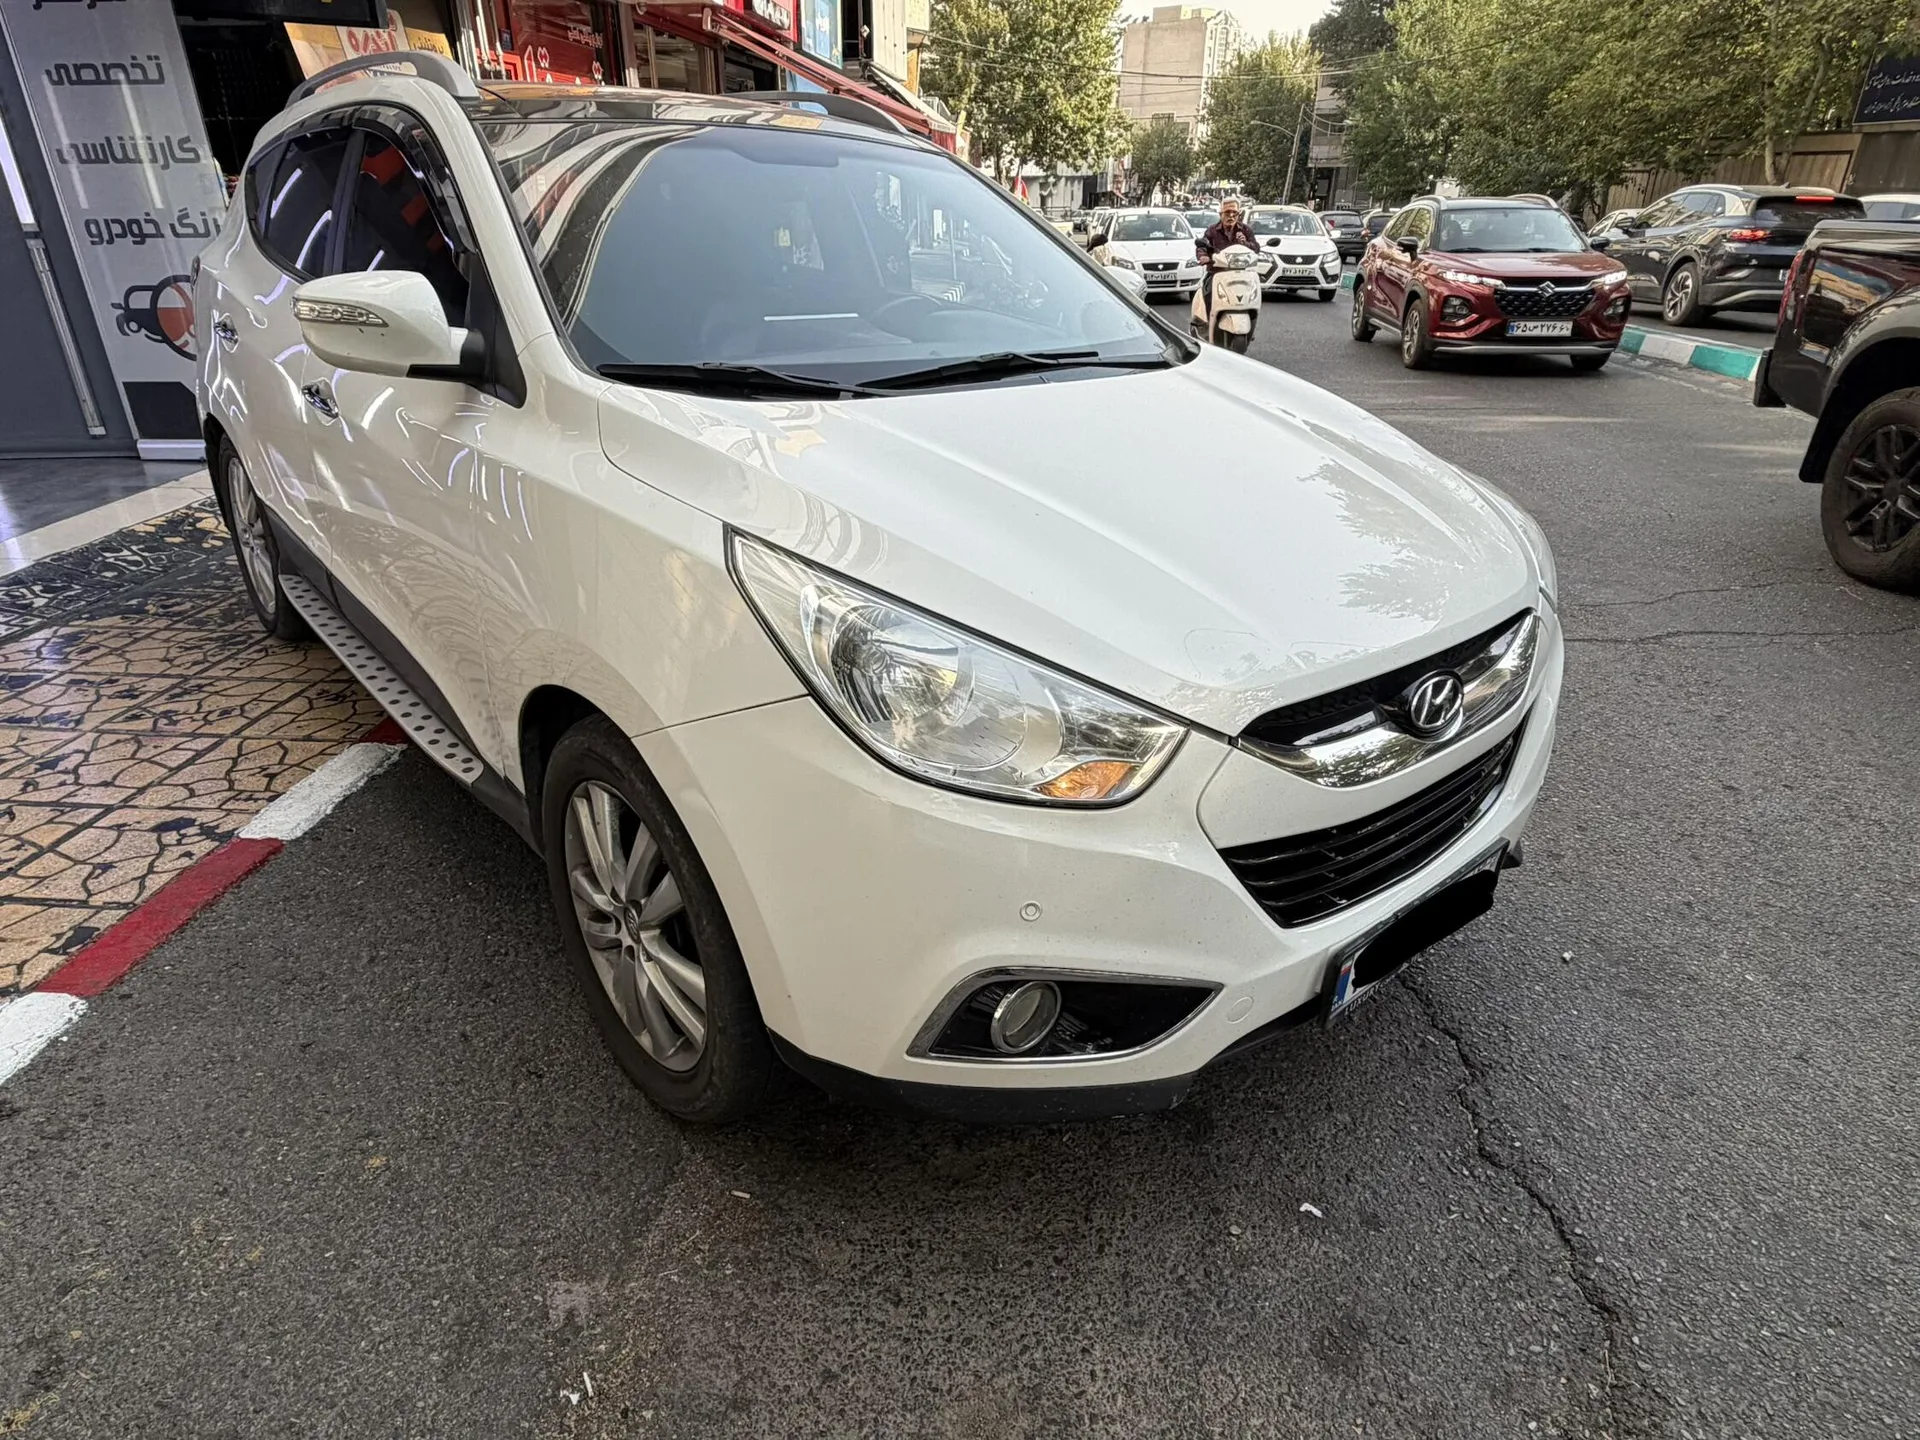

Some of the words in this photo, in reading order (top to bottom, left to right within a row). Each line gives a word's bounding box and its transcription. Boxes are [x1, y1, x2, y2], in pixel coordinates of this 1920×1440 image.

[44, 55, 165, 86] تخصصی
[55, 135, 201, 170] کارشناسی
[84, 212, 165, 246] خودرو
[169, 207, 222, 239] رنگ
